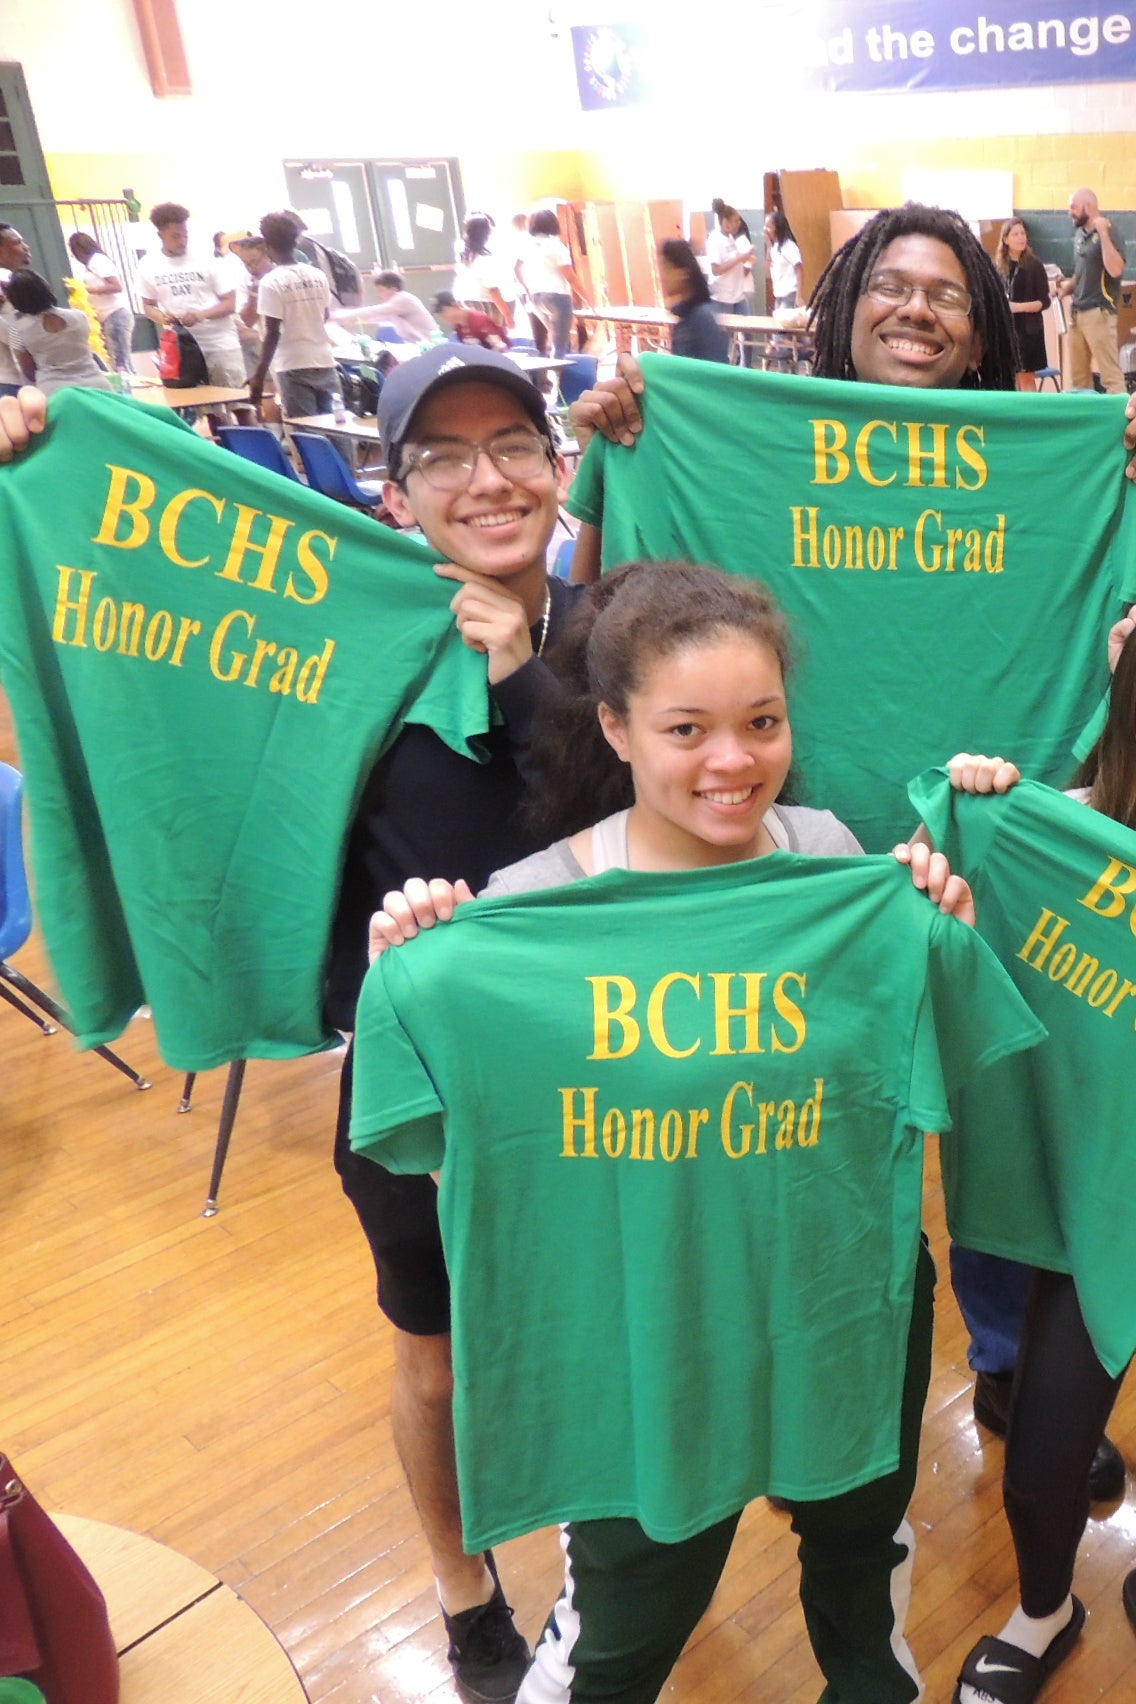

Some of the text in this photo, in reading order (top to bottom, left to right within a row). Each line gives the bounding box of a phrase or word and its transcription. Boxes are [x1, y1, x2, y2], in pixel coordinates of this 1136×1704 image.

[866, 24, 935, 62] the
[949, 13, 1132, 56] change
[171, 284, 192, 297] DAY
[808, 419, 989, 490] BCHS
[92, 464, 338, 605] BCHS
[789, 506, 1006, 574] Honor Grad
[52, 565, 337, 704] Honor Grad
[584, 971, 807, 1061] BCHS
[557, 1077, 825, 1163] Honor Grad
